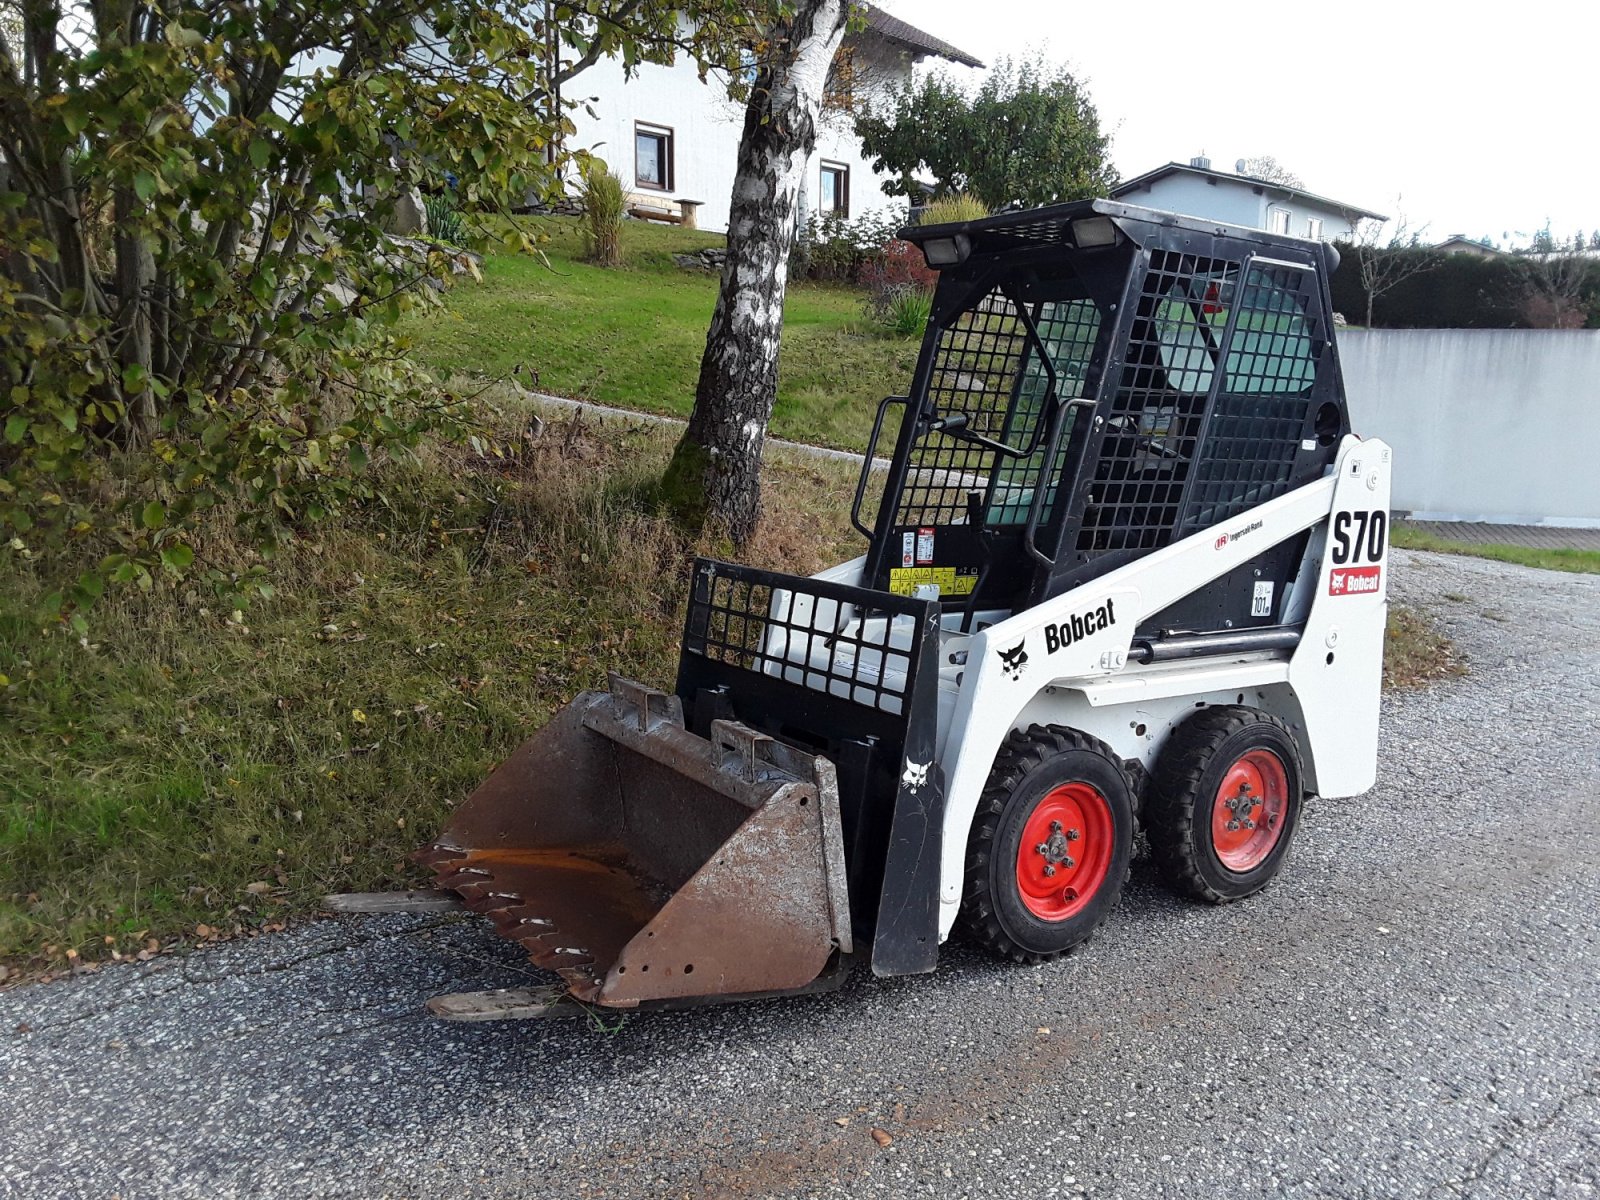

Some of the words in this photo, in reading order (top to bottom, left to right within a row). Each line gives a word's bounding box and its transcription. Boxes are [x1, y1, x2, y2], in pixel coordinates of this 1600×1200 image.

[1250, 519, 1263, 531] Rand
[1332, 510, 1386, 564] S70
[1347, 574, 1378, 592] Bobcat
[1254, 596, 1267, 614] 101
[1044, 598, 1116, 655] Bobcat
